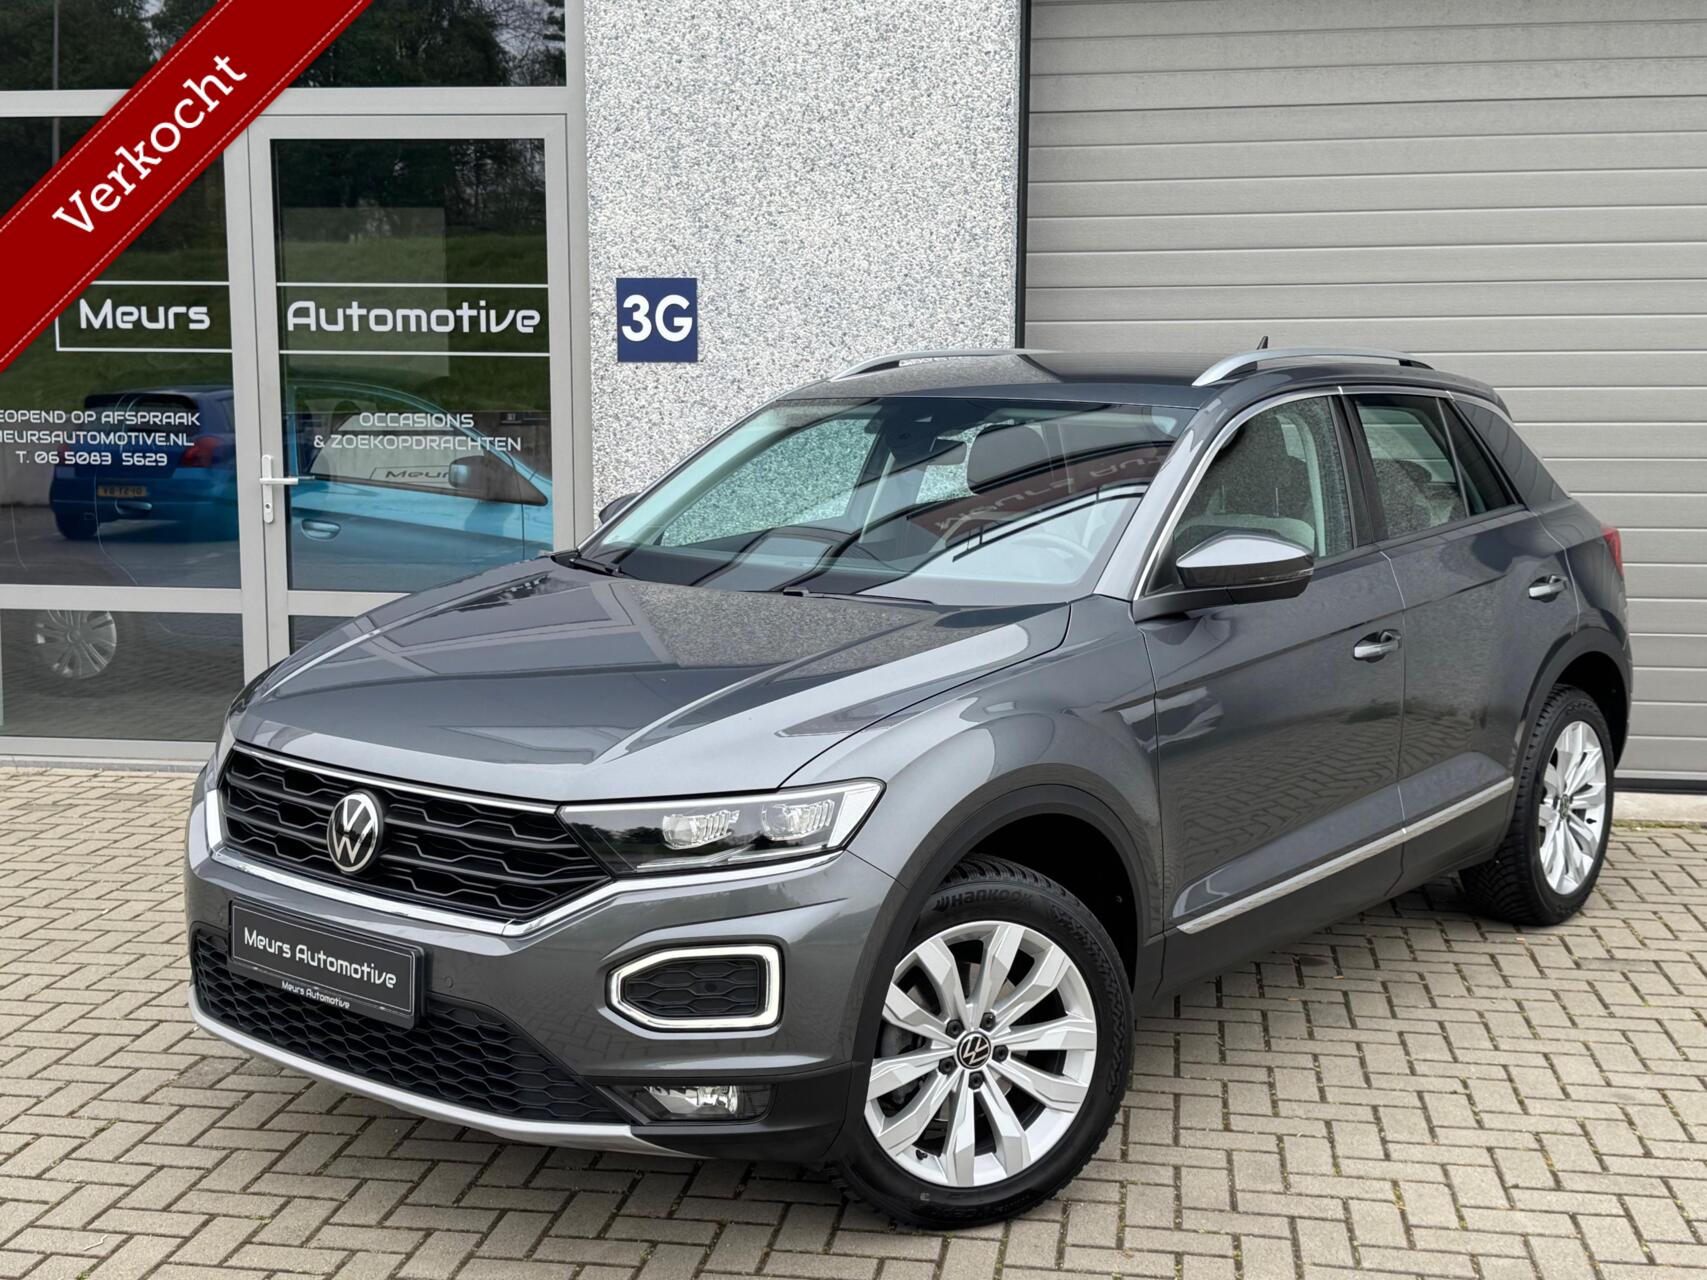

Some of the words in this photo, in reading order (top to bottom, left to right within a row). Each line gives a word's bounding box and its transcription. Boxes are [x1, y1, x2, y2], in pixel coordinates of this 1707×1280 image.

[79, 298, 211, 331] Meurs
[287, 300, 541, 334] Automotive
[621, 294, 693, 342] 3G
[71, 411, 97, 424] OP
[101, 412, 201, 426] AFSPRAAK
[359, 412, 475, 428] OCCASIONS
[0, 430, 195, 446] EURSAUTOMOTIVE.NL
[313, 434, 325, 448] &
[330, 434, 521, 451] ZOEKOPDRACHTEN
[16, 451, 30, 464] T.
[34, 451, 60, 464] 06
[64, 452, 112, 465] 5083
[122, 453, 168, 466] 5629
[244, 927, 291, 958] Meurs
[295, 945, 397, 989] Automotive
[281, 980, 305, 996] Meurs
[306, 989, 350, 1009] Automotive
